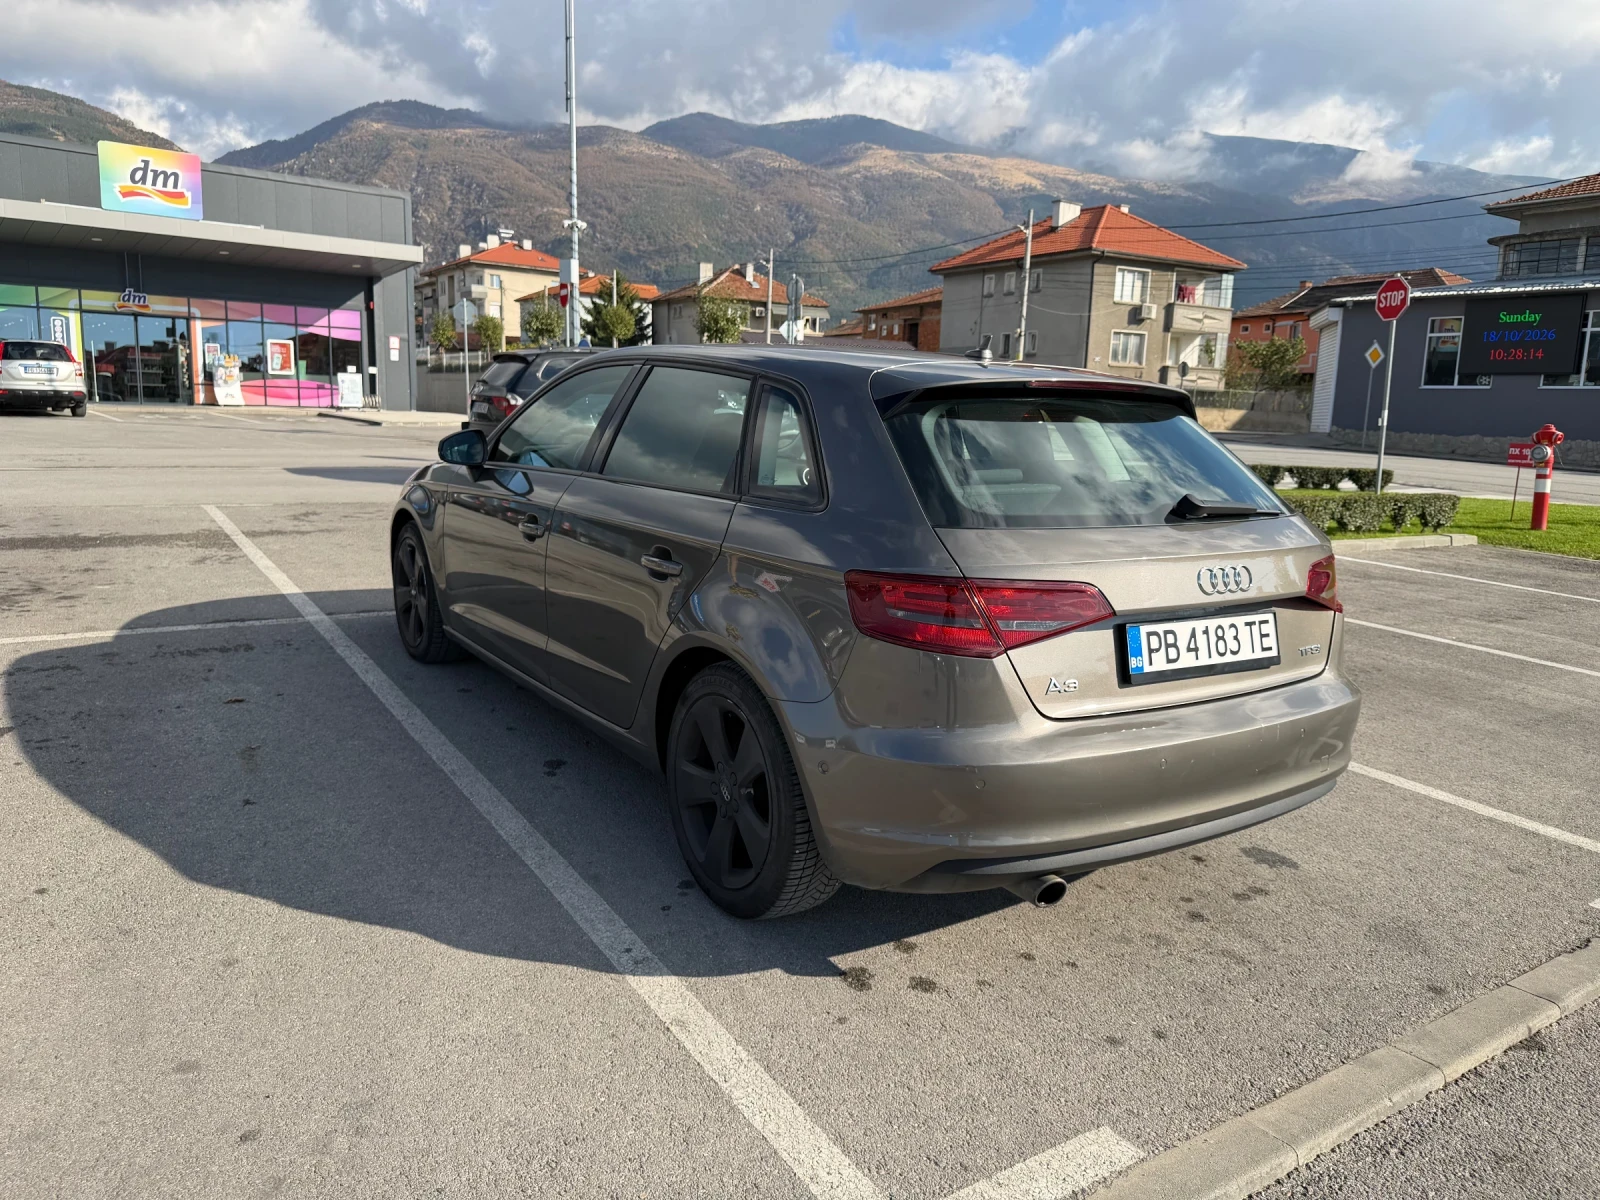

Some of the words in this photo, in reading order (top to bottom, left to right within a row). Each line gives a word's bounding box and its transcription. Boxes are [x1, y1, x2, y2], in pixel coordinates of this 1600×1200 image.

[129, 159, 180, 190] dm
[121, 289, 148, 305] dm
[1379, 290, 1405, 308] STOP
[1499, 309, 1542, 326] Sunday
[1483, 329, 1555, 342] 18/10/2026
[1489, 348, 1544, 361] 10:28:14
[1145, 628, 1181, 667] PB
[1186, 622, 1242, 661] 4183
[1244, 619, 1273, 655] TE
[1297, 643, 1321, 657] TFSI
[1130, 656, 1143, 669] BG
[1044, 676, 1079, 696] A3
